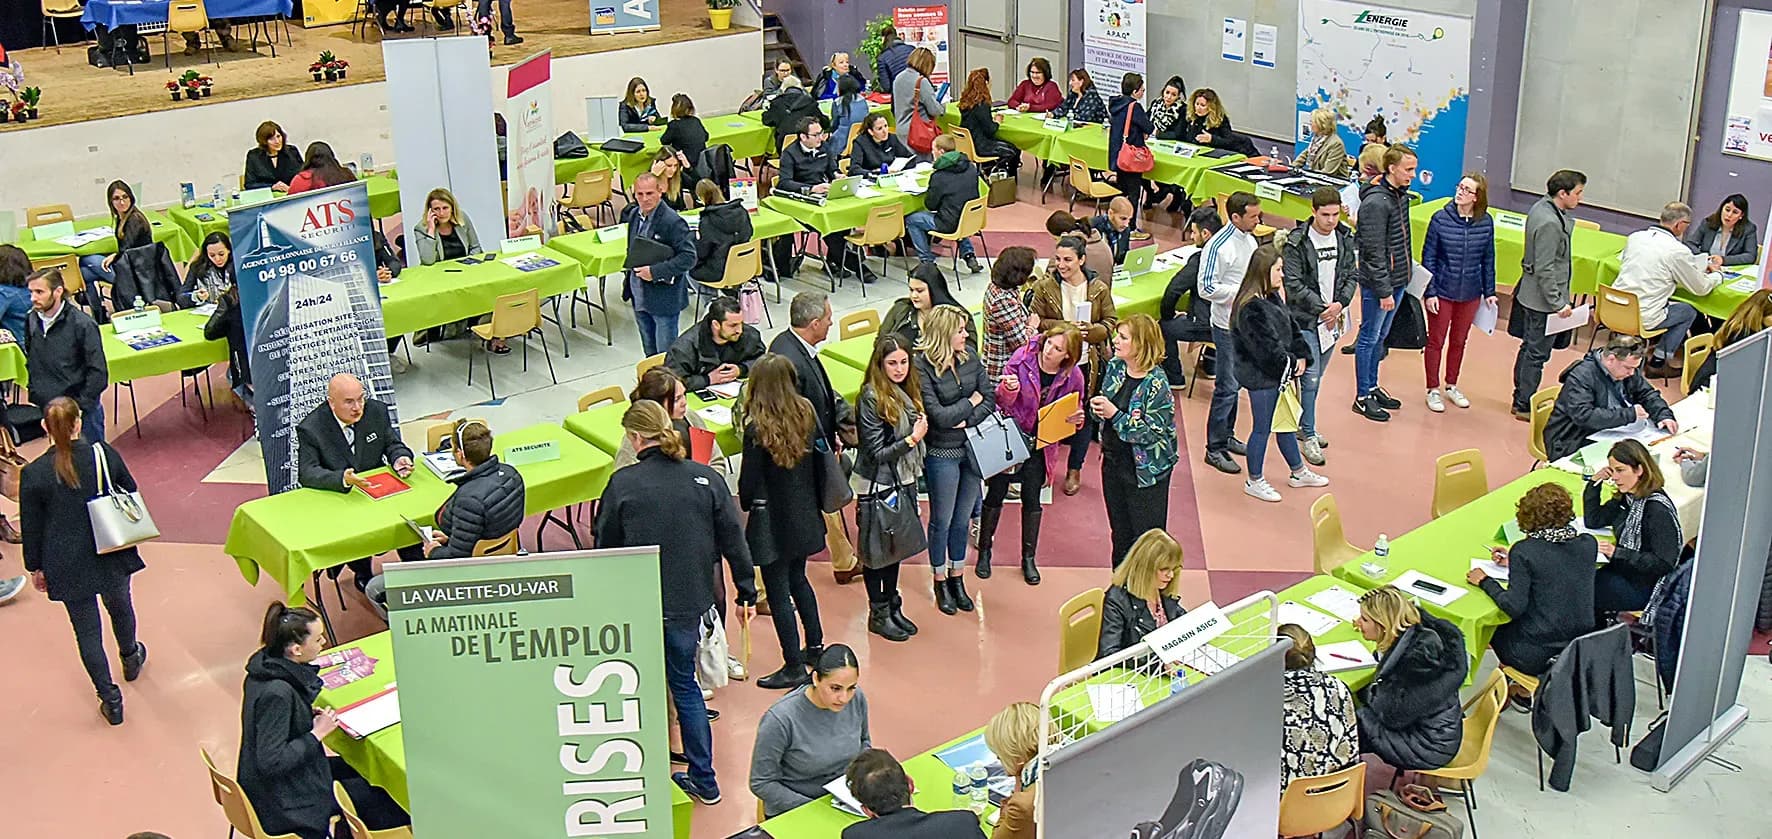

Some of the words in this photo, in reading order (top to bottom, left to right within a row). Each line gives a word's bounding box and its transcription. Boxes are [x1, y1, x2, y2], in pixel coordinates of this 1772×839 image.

[301, 199, 356, 232] ATS
[241, 260, 269, 270] AGENCE
[269, 248, 313, 263] TOULONNAISE
[258, 270, 276, 282] 04
[278, 264, 296, 277] 98
[299, 260, 317, 272] 00
[319, 254, 336, 268] 67
[340, 250, 357, 263] 66
[295, 294, 333, 309] 24h/24
[282, 339, 326, 357] PRESTIGES
[321, 349, 332, 357] DE
[334, 344, 354, 354] LUXE
[278, 366, 315, 381] CENTRES
[293, 375, 330, 388] PARKING
[402, 590, 422, 604] LA
[425, 580, 559, 602] VALETTE-DU-VAR
[405, 618, 427, 635] LA
[431, 612, 518, 633] MATINALE
[1162, 630, 1196, 651] MAGASIN
[1196, 618, 1218, 633] ASICS
[451, 635, 479, 656] DE
[483, 624, 632, 663] L'EMPLOI
